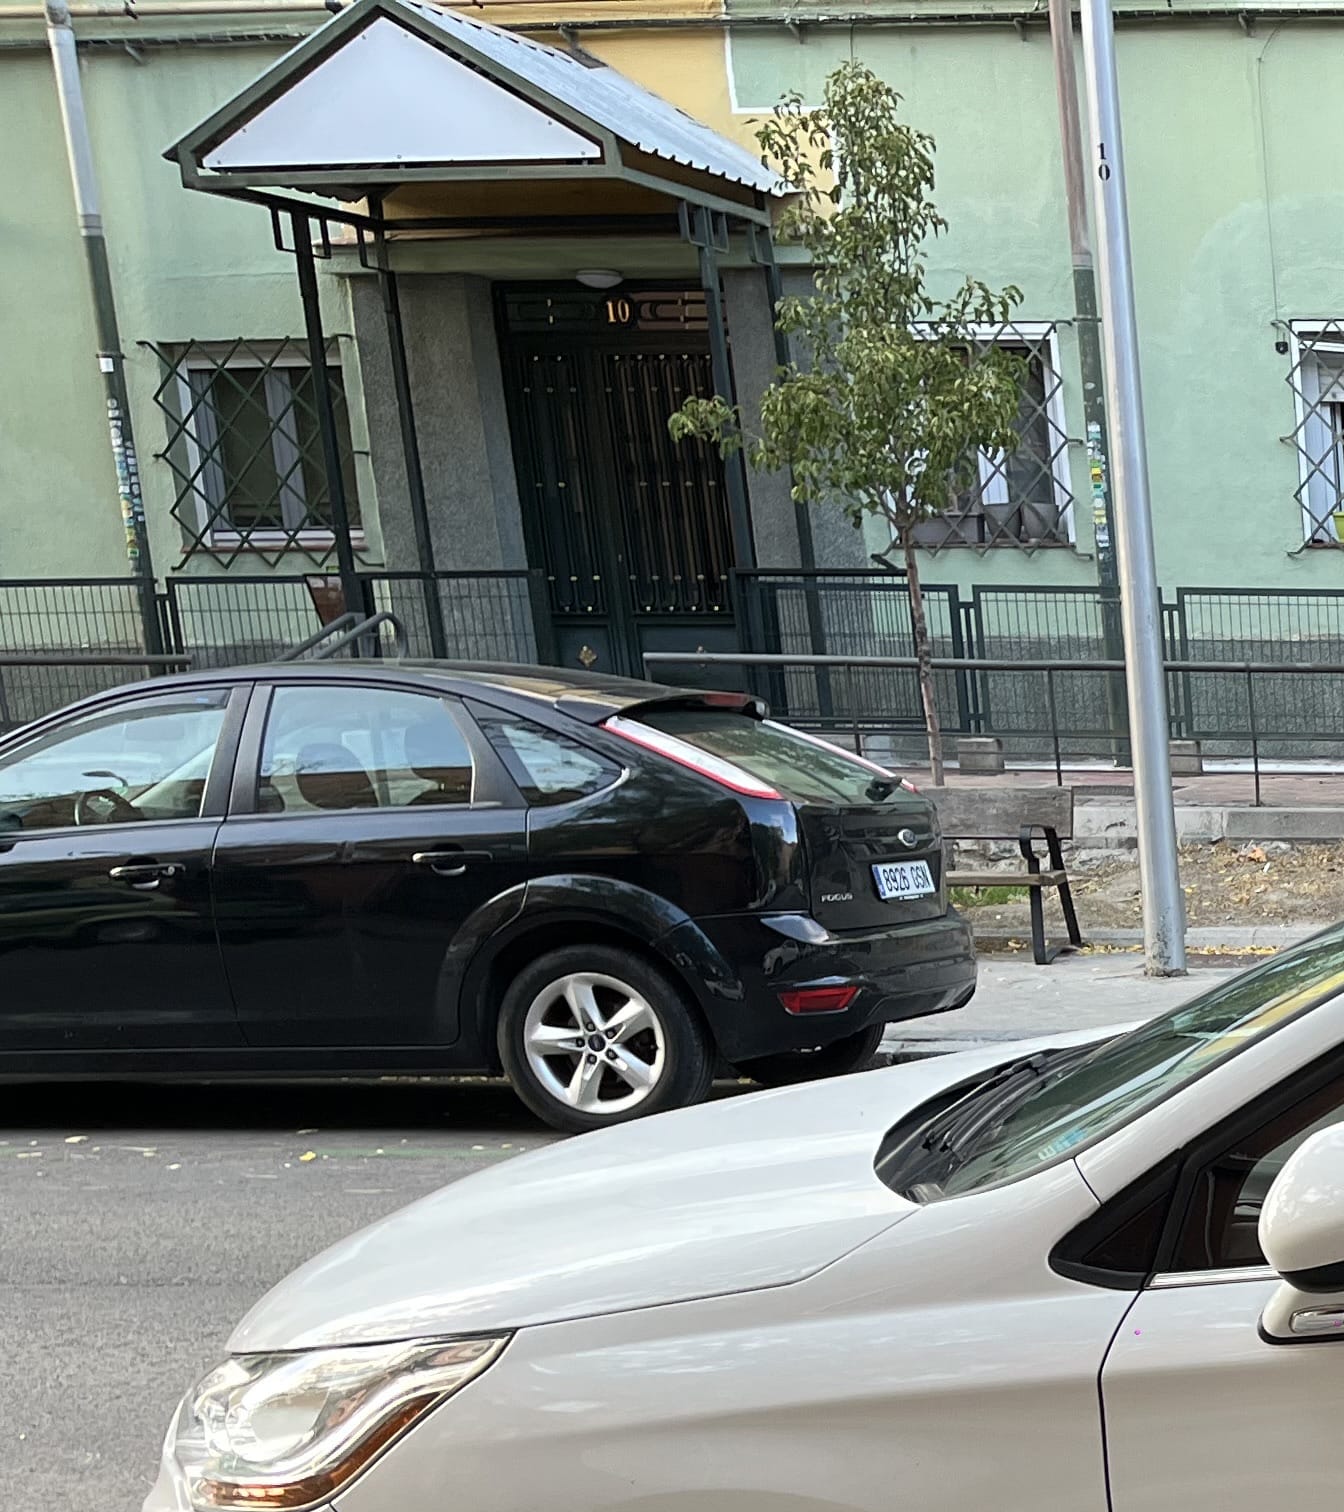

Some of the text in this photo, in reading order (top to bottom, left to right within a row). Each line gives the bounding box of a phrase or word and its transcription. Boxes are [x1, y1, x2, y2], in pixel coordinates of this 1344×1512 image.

[606, 300, 629, 323] 10
[882, 865, 931, 892] 8926 GSN
